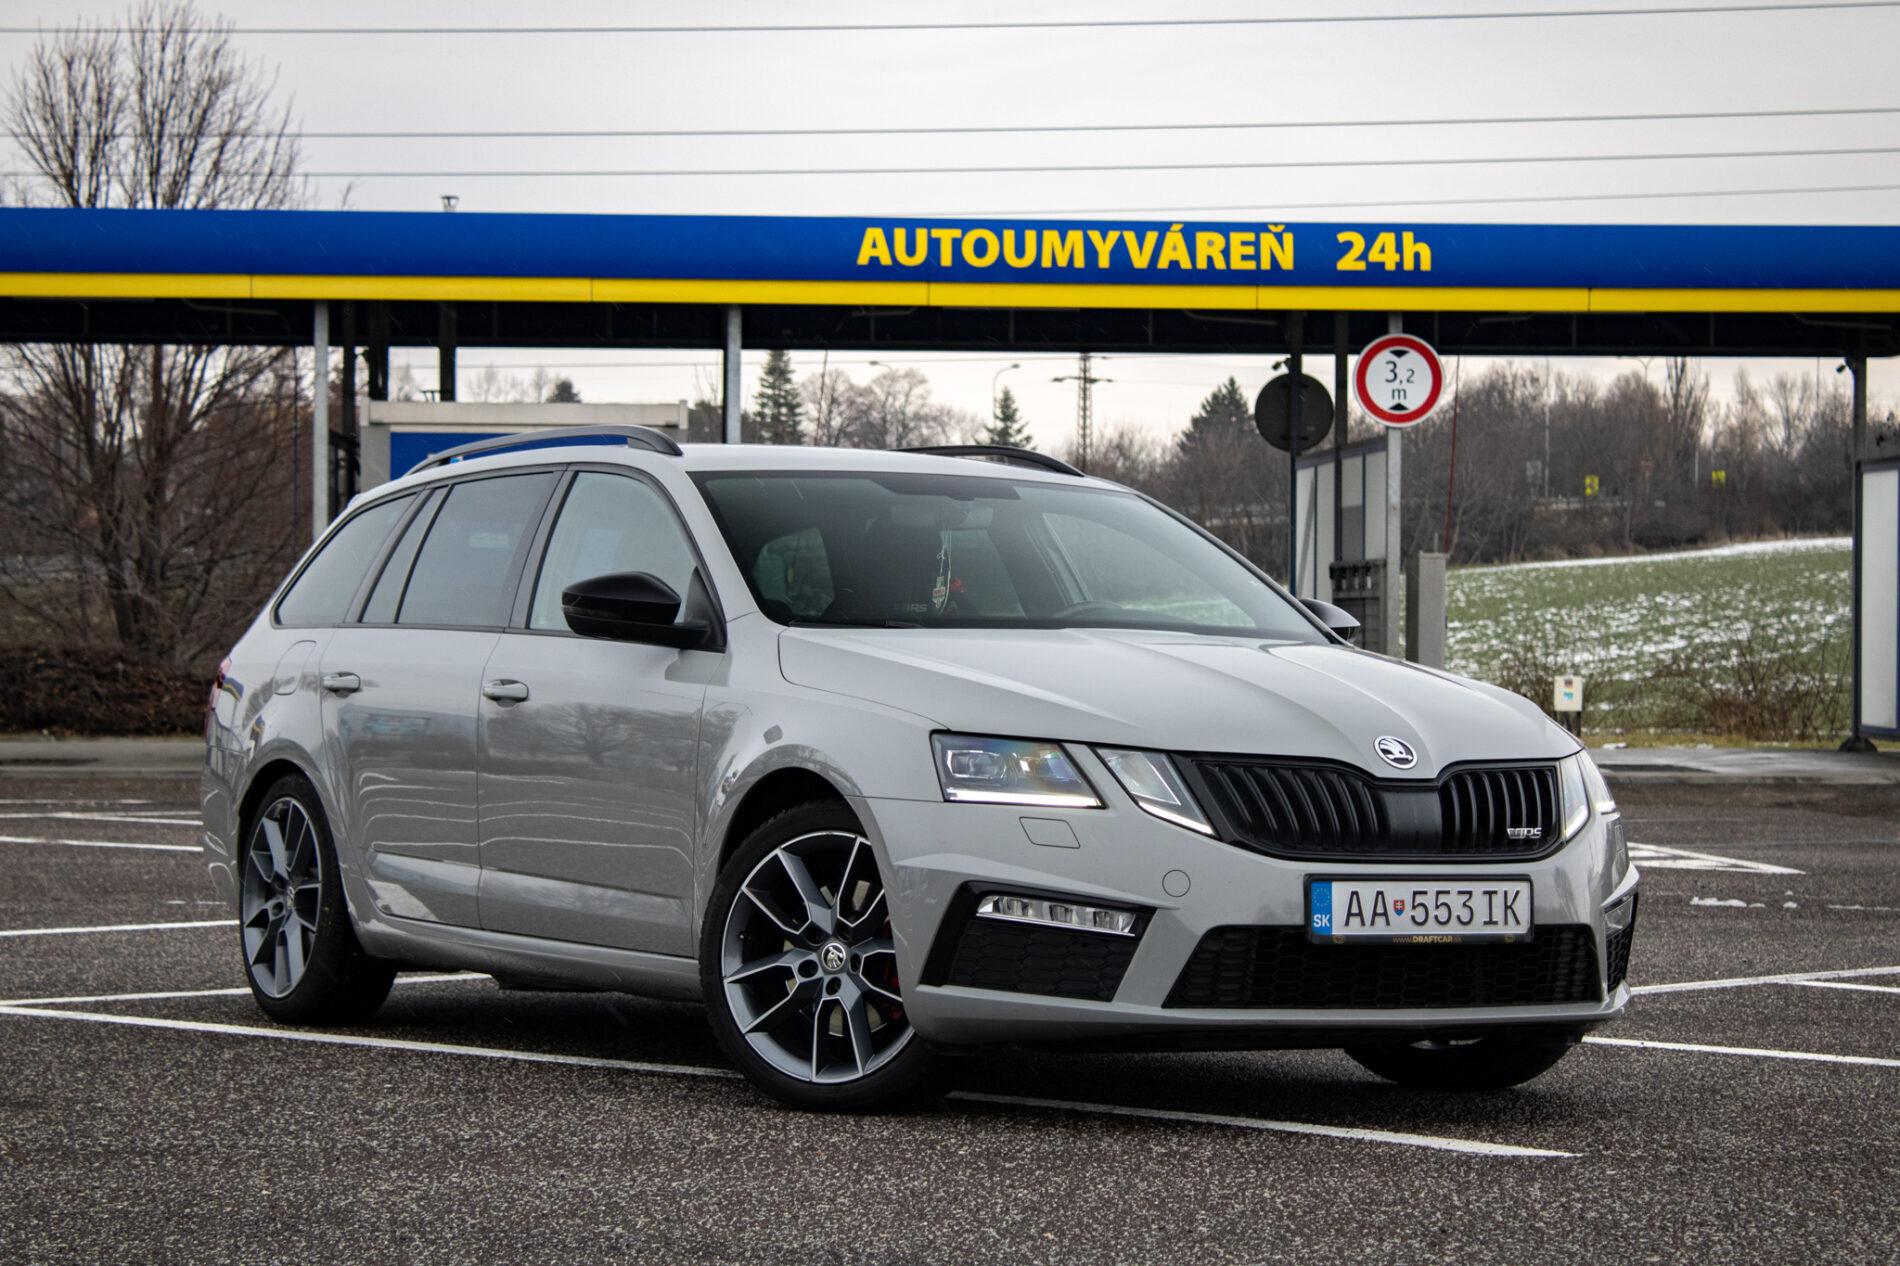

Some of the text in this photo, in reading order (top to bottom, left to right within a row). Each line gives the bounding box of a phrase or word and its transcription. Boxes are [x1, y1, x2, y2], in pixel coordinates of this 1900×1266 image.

[856, 223, 1432, 271] AUTOUMYVÁREŇ 24h
[1385, 360, 1415, 385] 3,2
[1391, 388, 1407, 400] m
[1344, 889, 1521, 927] AA 553IK
[1313, 914, 1330, 928] SK
